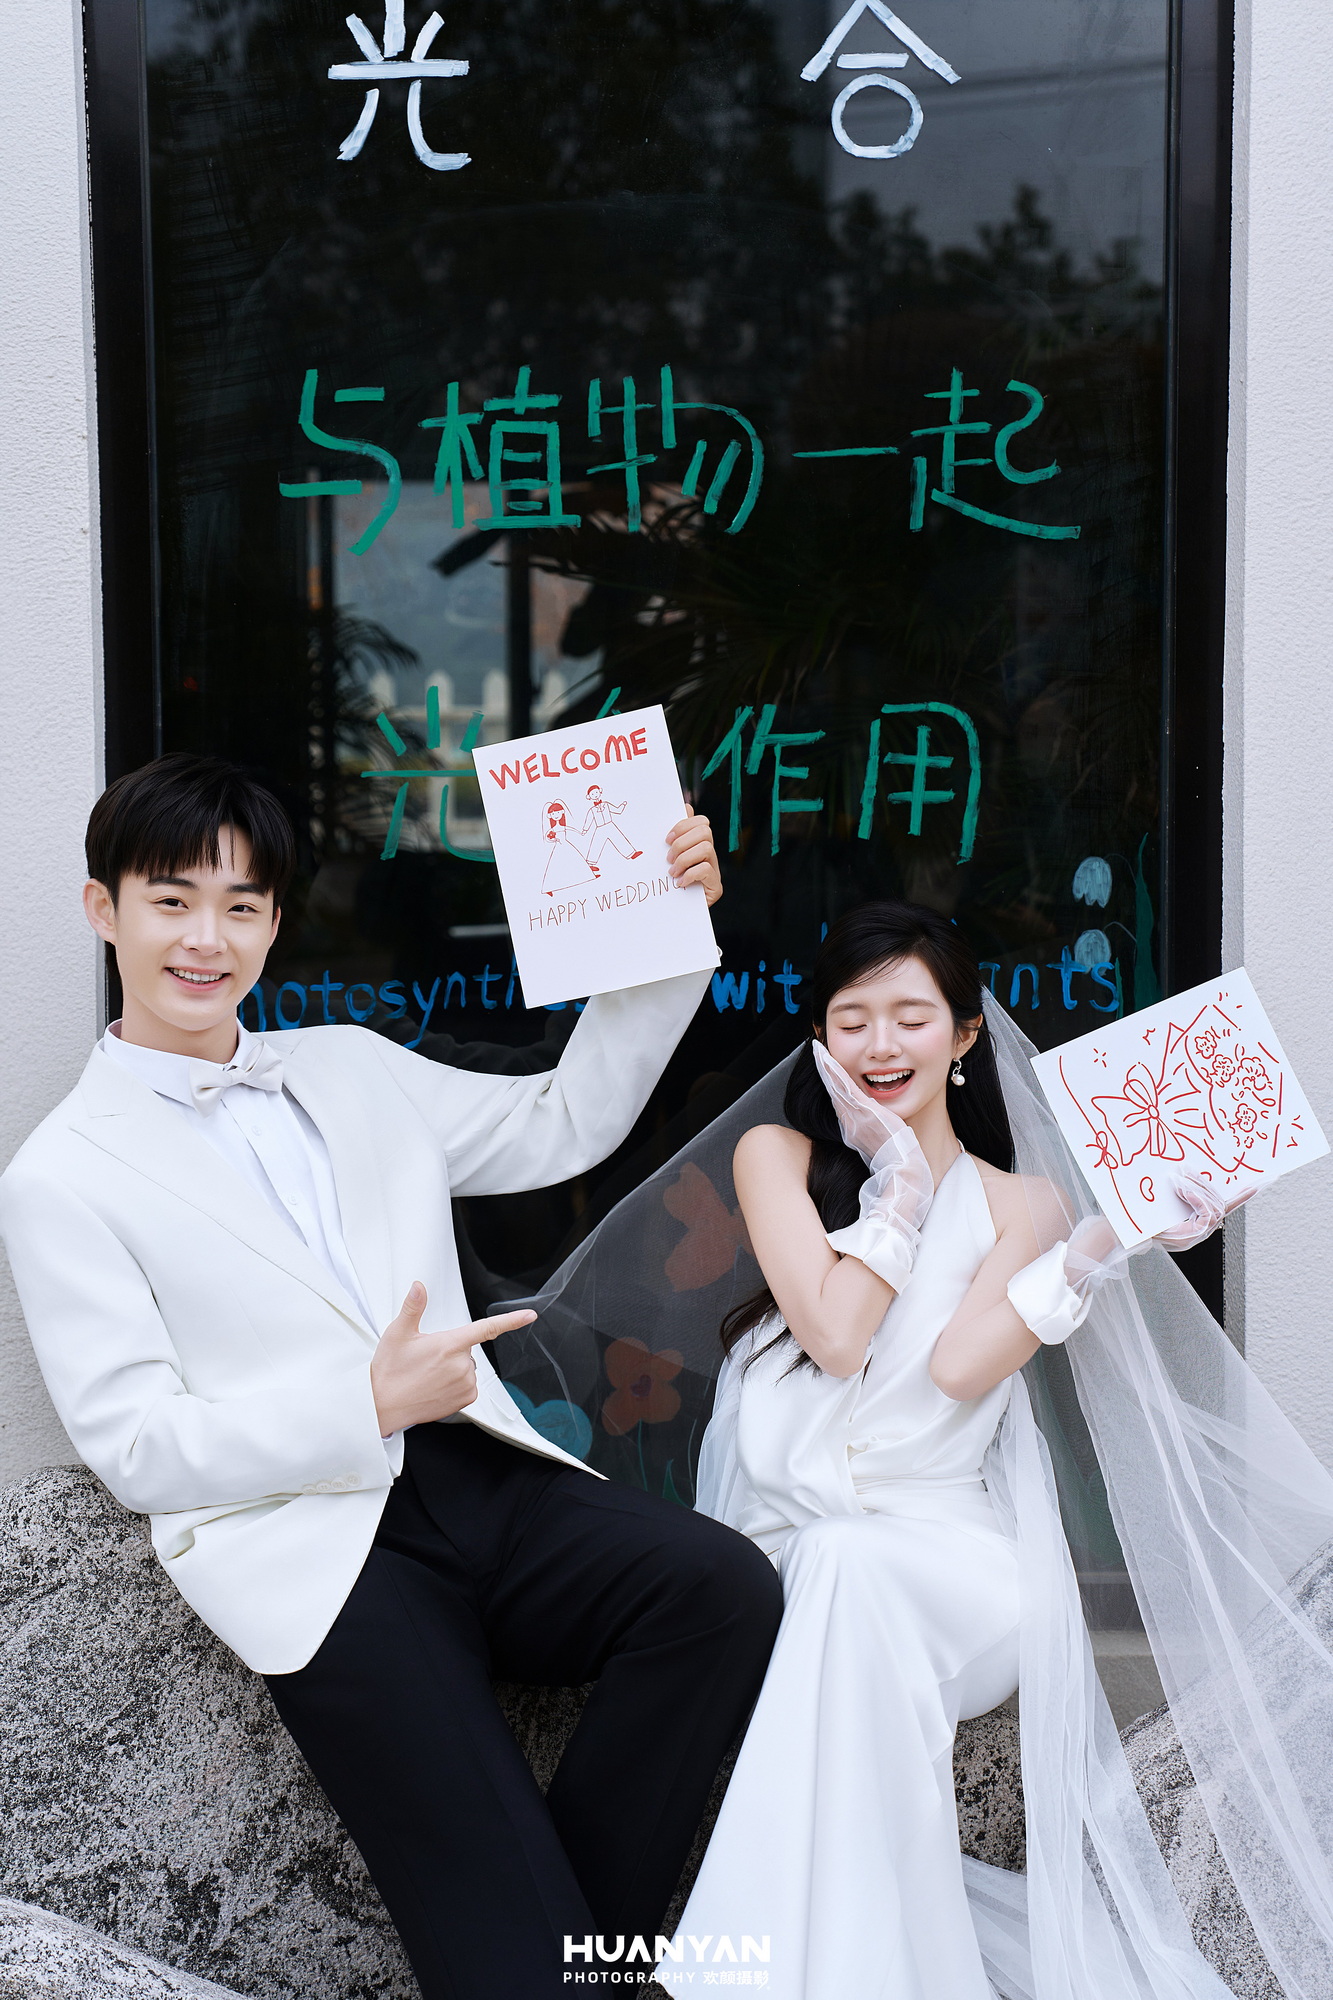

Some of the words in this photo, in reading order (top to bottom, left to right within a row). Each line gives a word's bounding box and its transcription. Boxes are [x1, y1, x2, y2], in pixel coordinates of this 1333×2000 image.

[328, 0, 472, 170] 光
[800, 0, 962, 159] 合
[279, 364, 1082, 556] 与植物一起
[360, 686, 982, 865] 光作用
[488, 727, 648, 790] WELCOME
[528, 898, 588, 931] HAPPY
